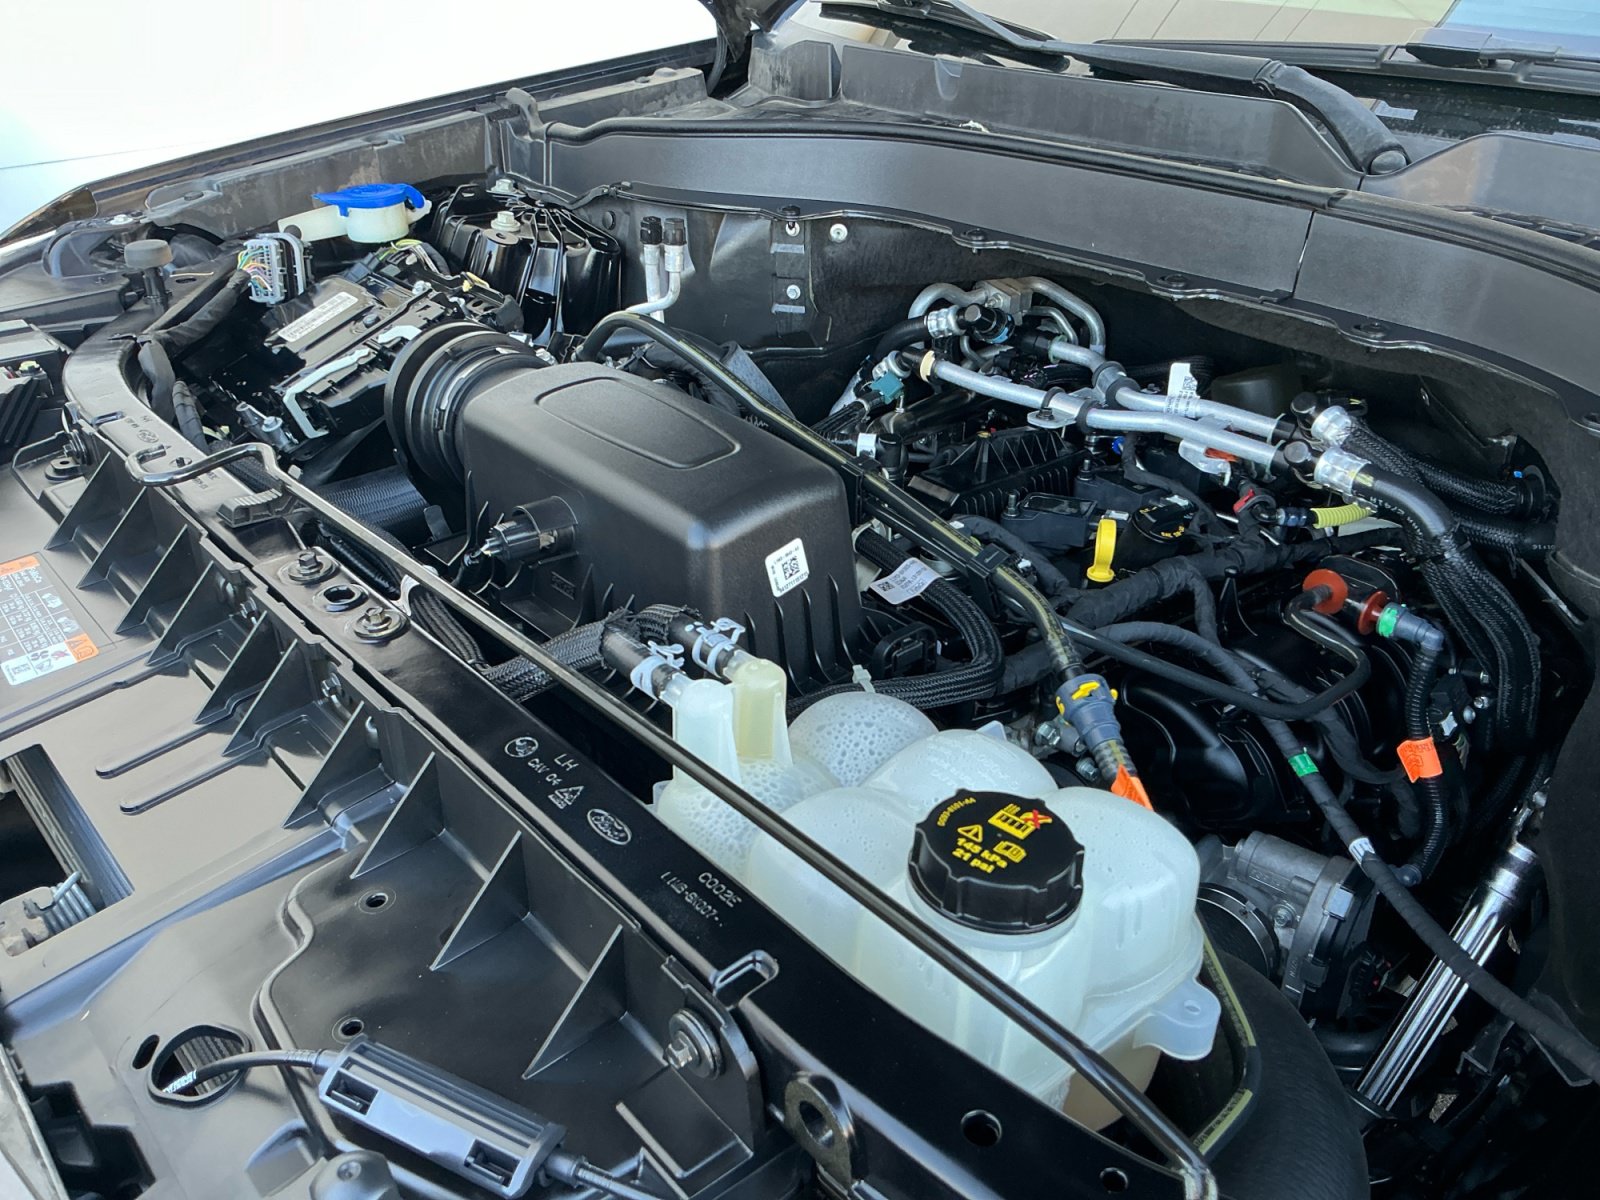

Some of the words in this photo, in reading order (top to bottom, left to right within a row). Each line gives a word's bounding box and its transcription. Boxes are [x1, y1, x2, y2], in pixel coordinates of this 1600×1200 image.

[553, 753, 580, 772] LH
[952, 847, 971, 862] 21
[969, 857, 996, 874] psi
[956, 837, 983, 854] 145
[981, 849, 1008, 869] kPa
